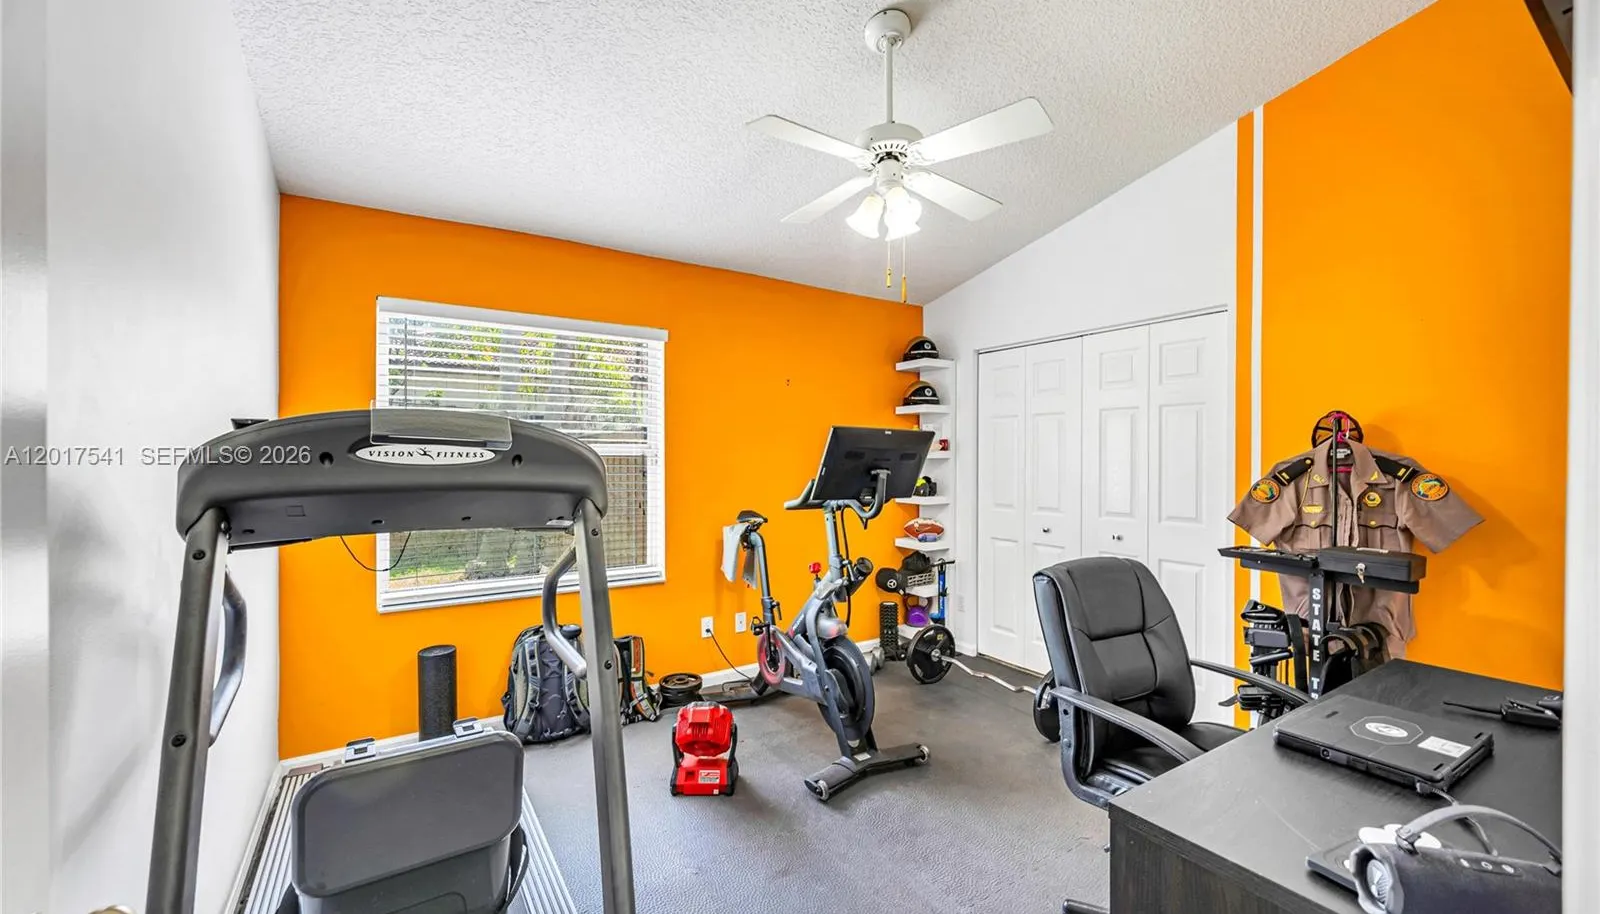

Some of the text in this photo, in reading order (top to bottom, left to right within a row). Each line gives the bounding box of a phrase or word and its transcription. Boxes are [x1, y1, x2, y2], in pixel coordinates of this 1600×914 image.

[368, 450, 485, 459] VISION FITNESS
[1312, 588, 1321, 662] STATE
